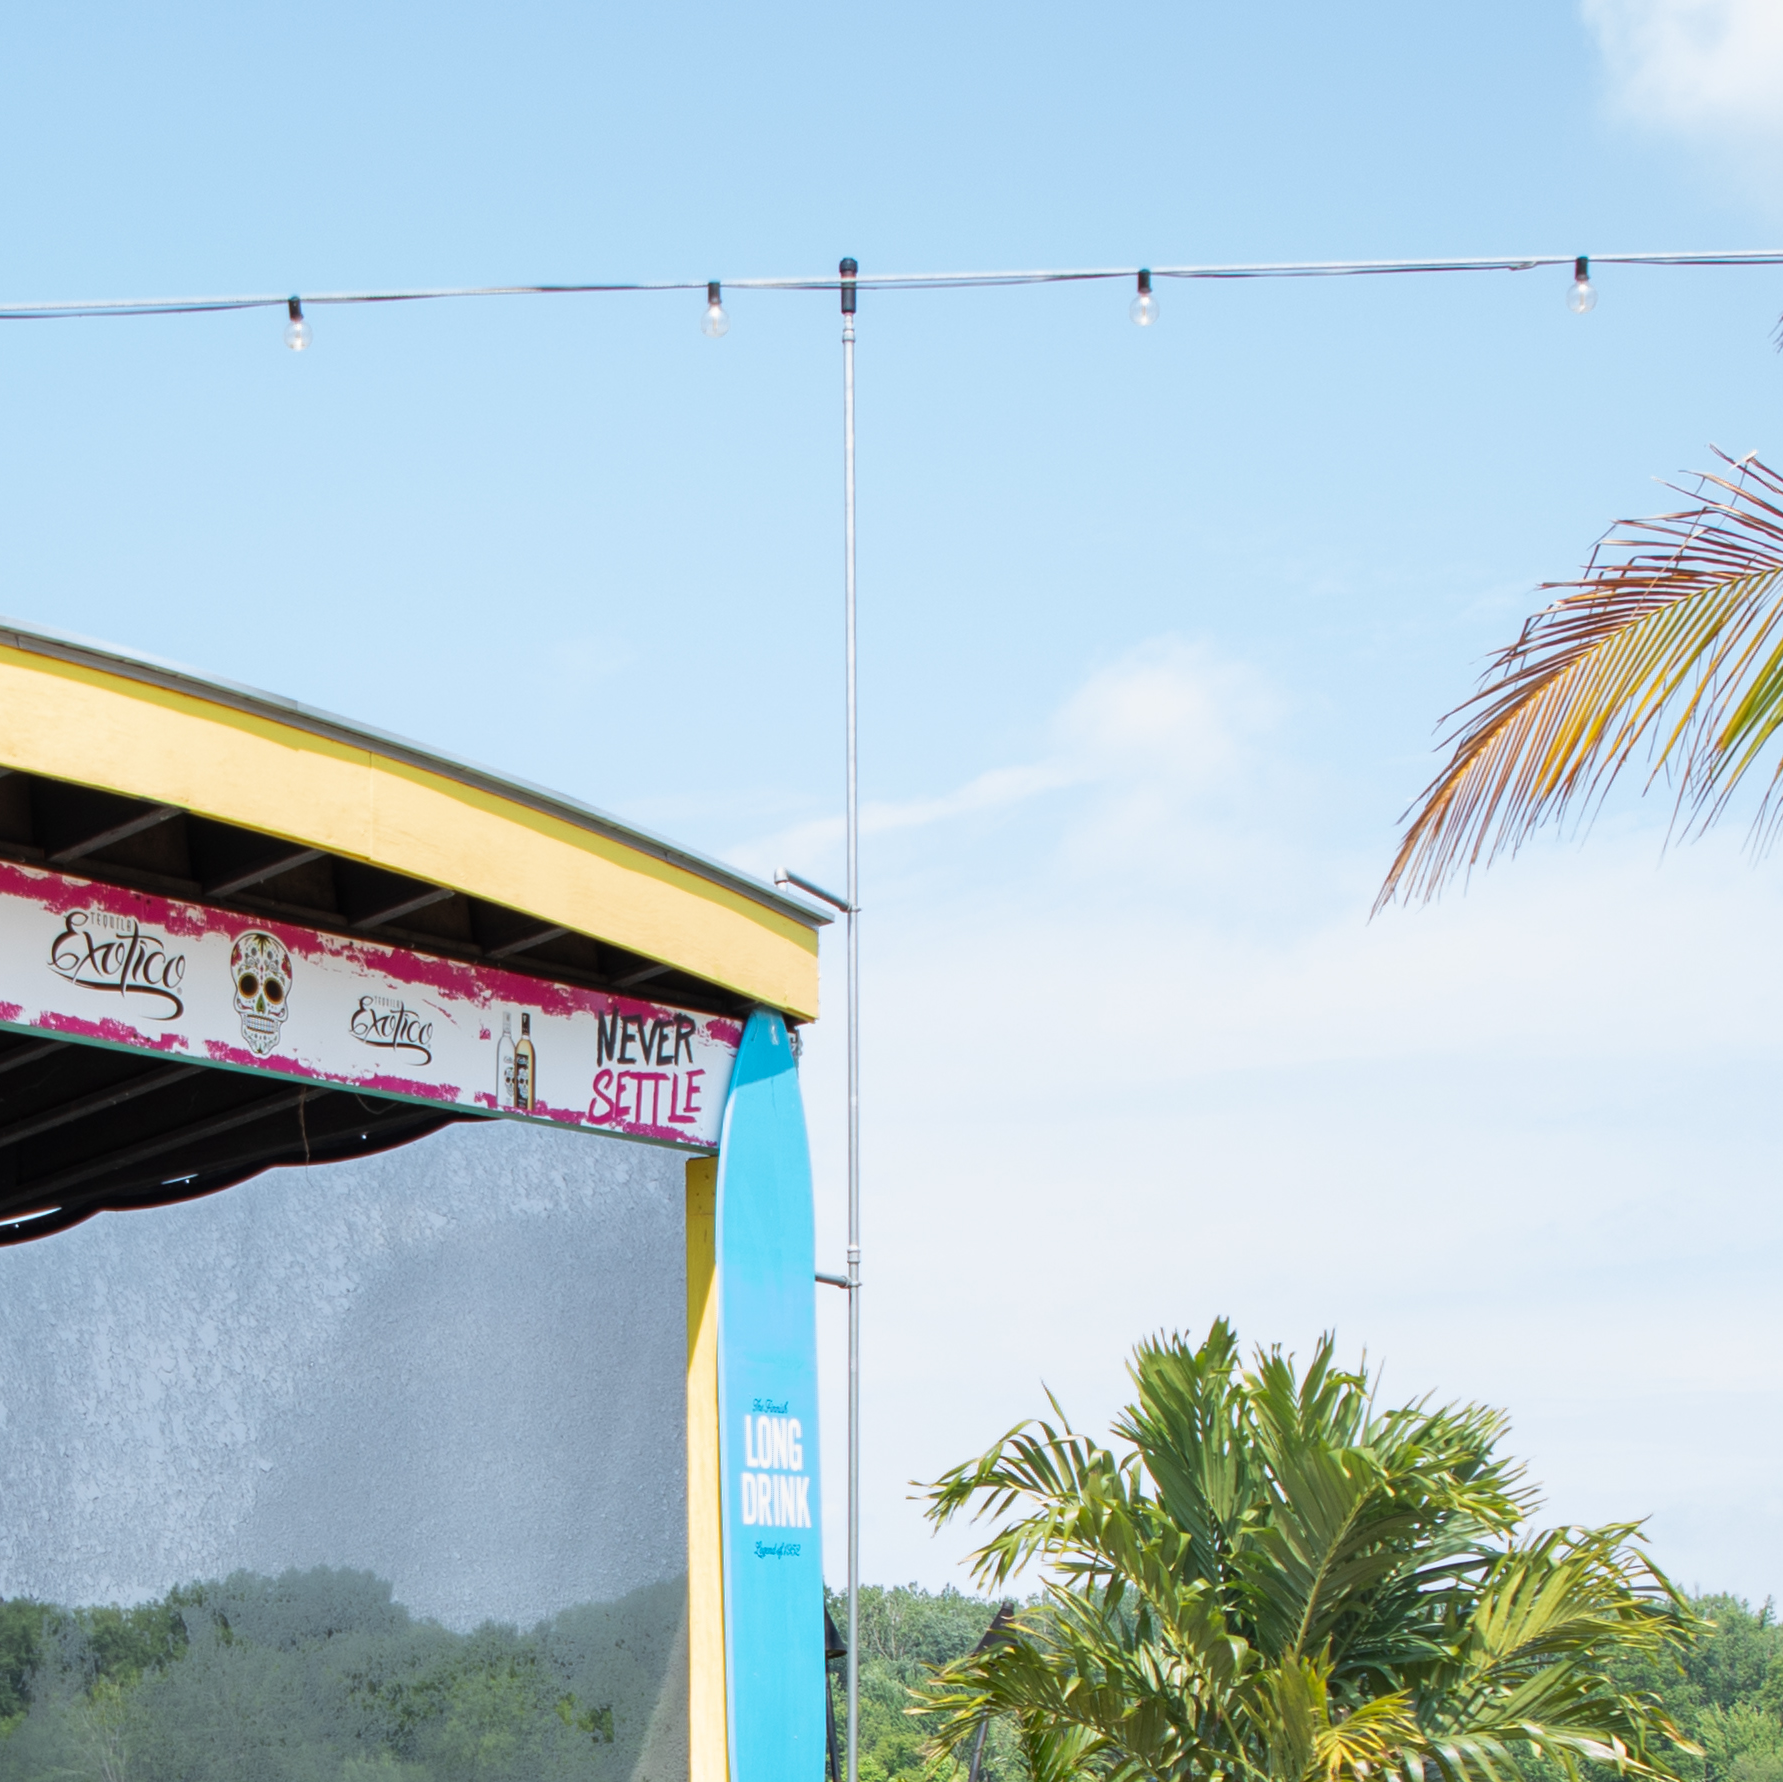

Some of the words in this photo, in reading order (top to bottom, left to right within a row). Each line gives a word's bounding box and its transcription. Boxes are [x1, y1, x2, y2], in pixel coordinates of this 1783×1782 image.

[90, 911, 132, 933] TEQUILA
[47, 910, 186, 1021] Exotico
[348, 995, 433, 1066] Exotico
[597, 1006, 696, 1068] NEVER
[586, 1068, 706, 1126] SETTLE
[744, 1414, 803, 1471] LONG
[741, 1471, 813, 1529] DRINK
